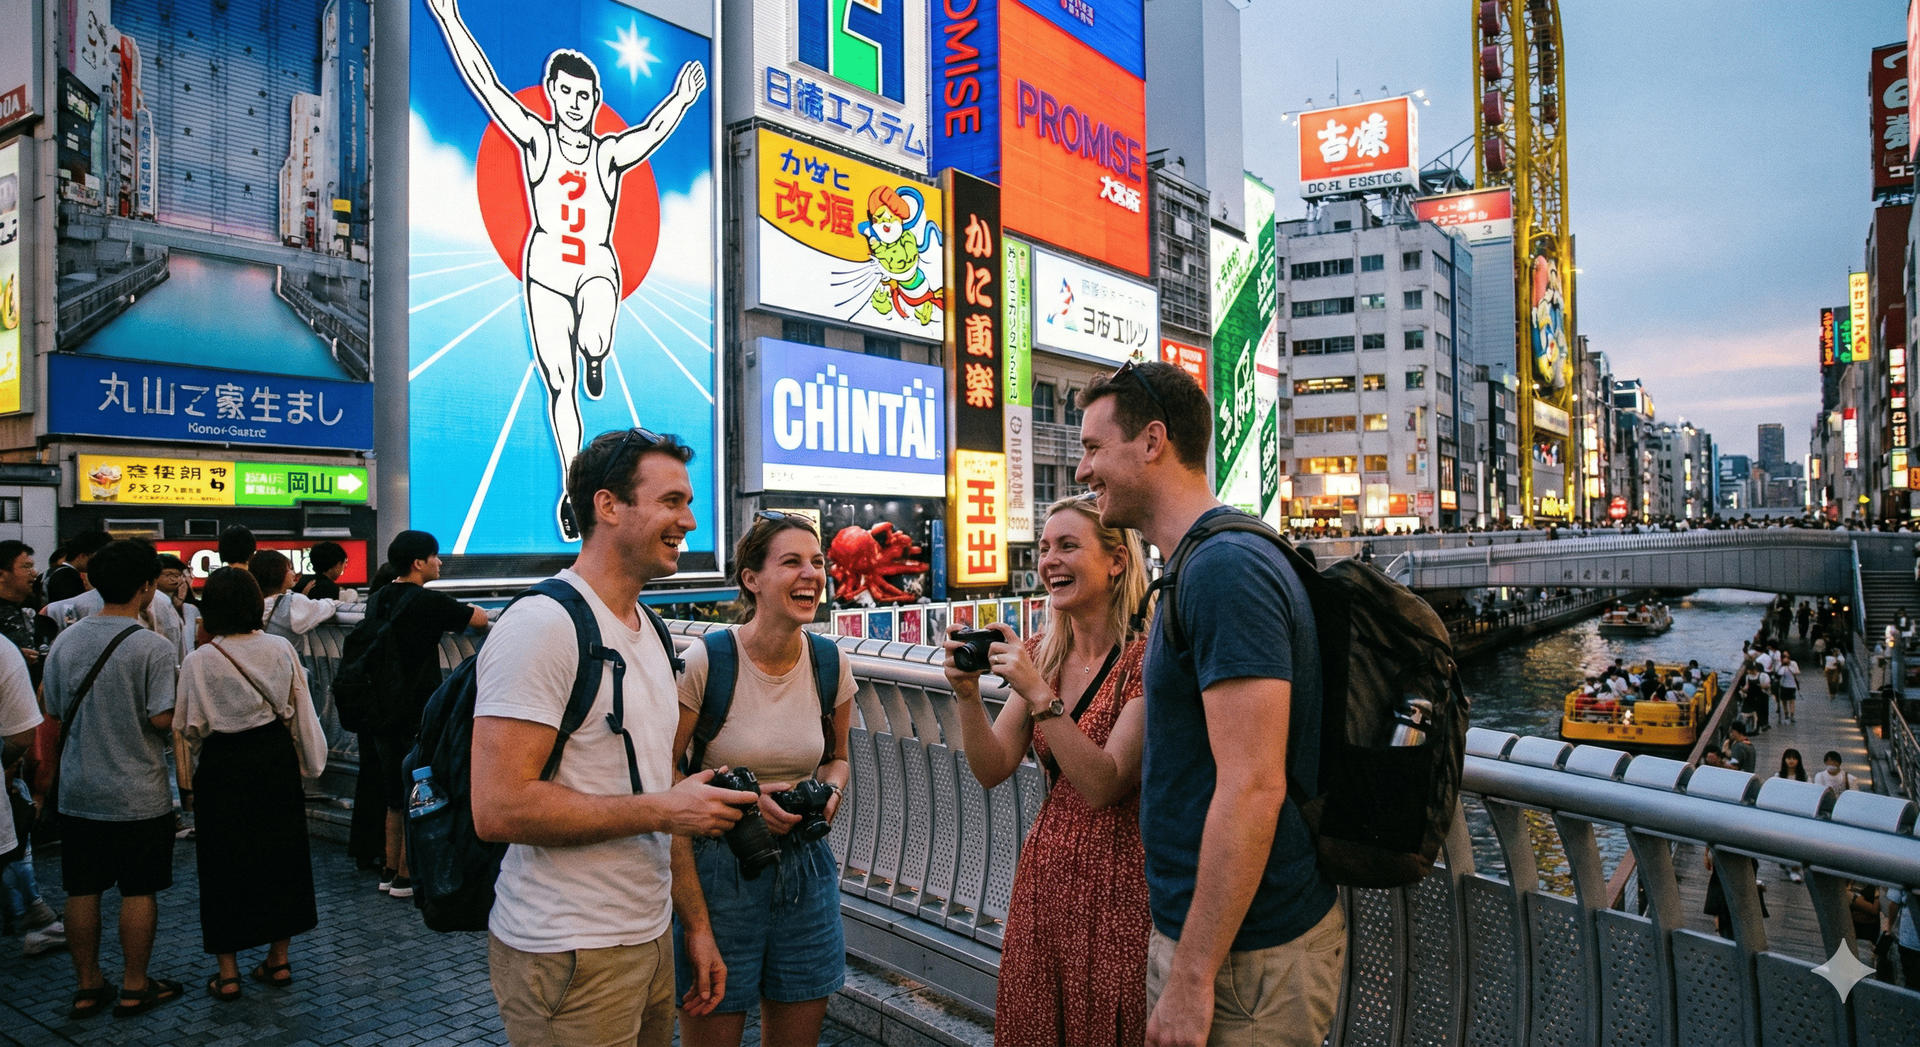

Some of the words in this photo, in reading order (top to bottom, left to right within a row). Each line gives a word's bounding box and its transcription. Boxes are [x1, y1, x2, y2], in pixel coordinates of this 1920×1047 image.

[1017, 78, 1142, 183] PROMISE
[558, 170, 587, 266] グリコ
[287, 471, 333, 494] 岡山
[966, 479, 997, 575] 玉出
